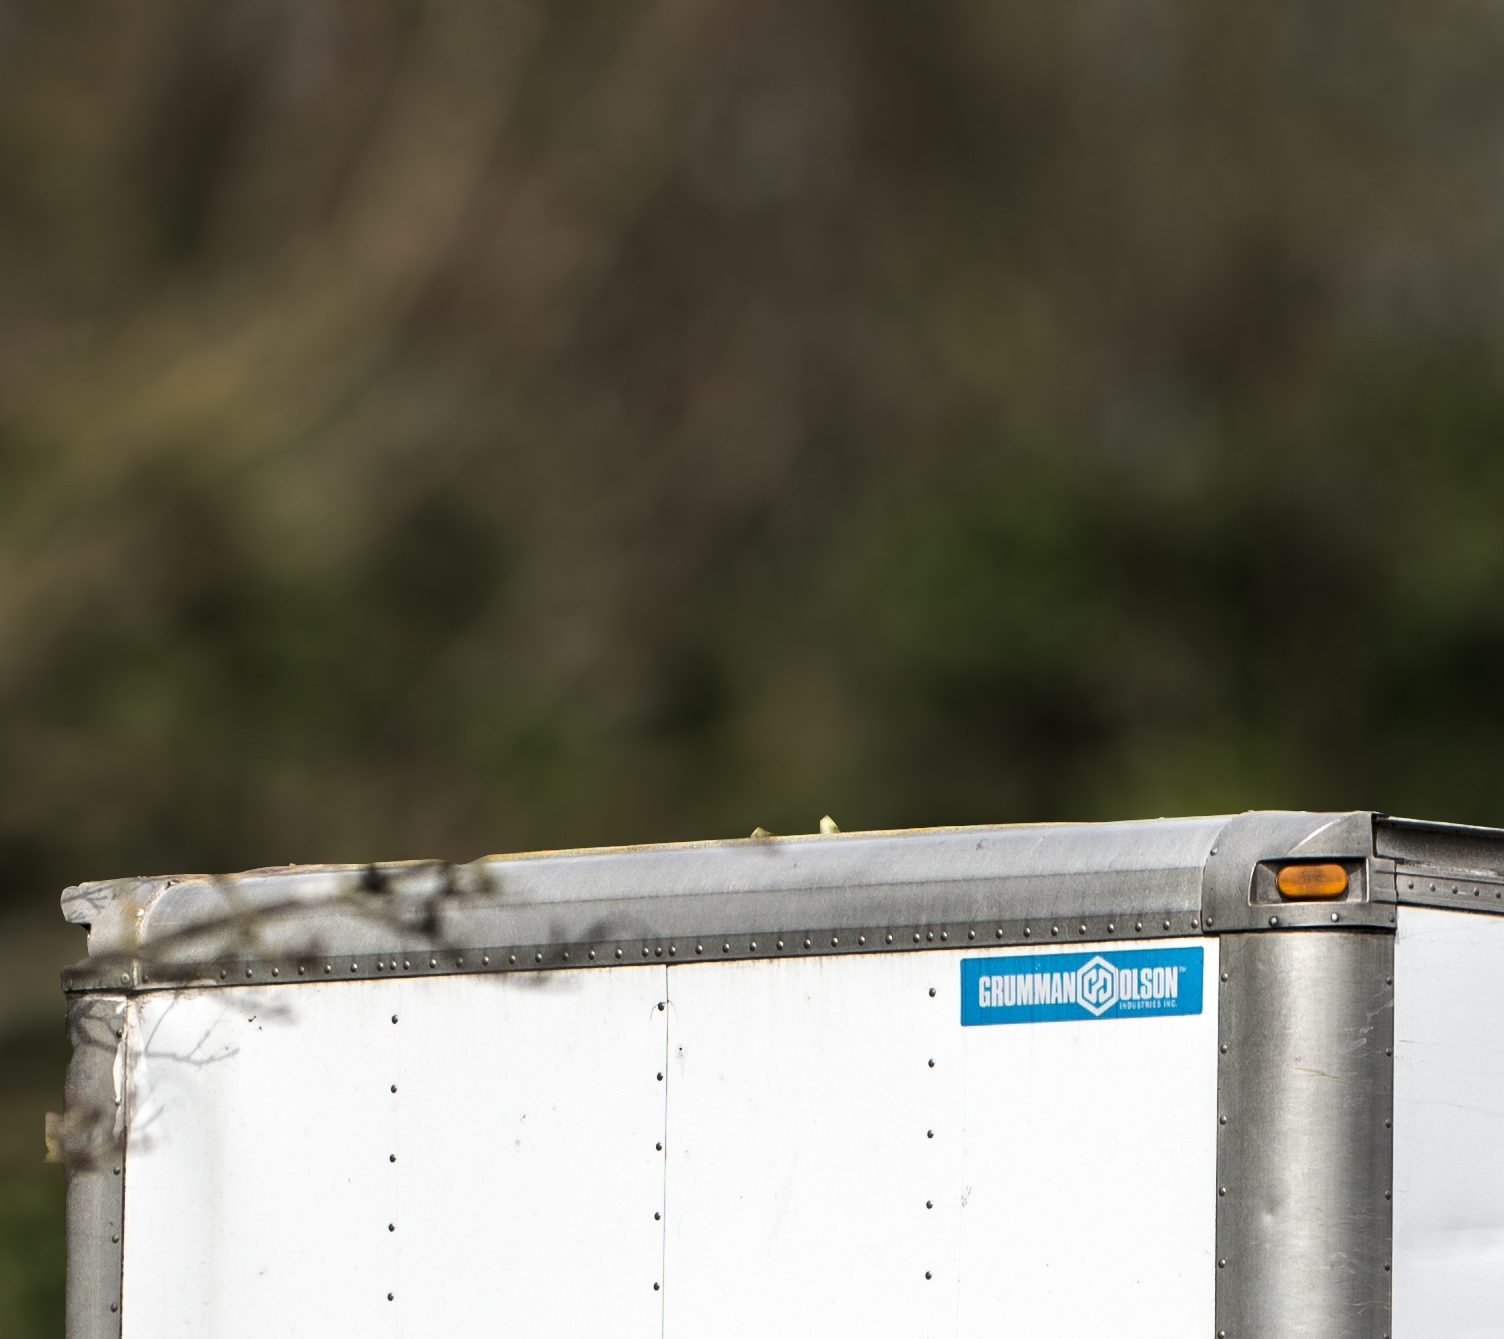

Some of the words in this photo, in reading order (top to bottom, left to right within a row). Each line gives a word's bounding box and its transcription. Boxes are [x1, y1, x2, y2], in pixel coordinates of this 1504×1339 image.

[979, 972, 1076, 1007] GRUMMAN
[1120, 966, 1178, 1000] OLSON
[1119, 1000, 1161, 1010] INDUSTRIES
